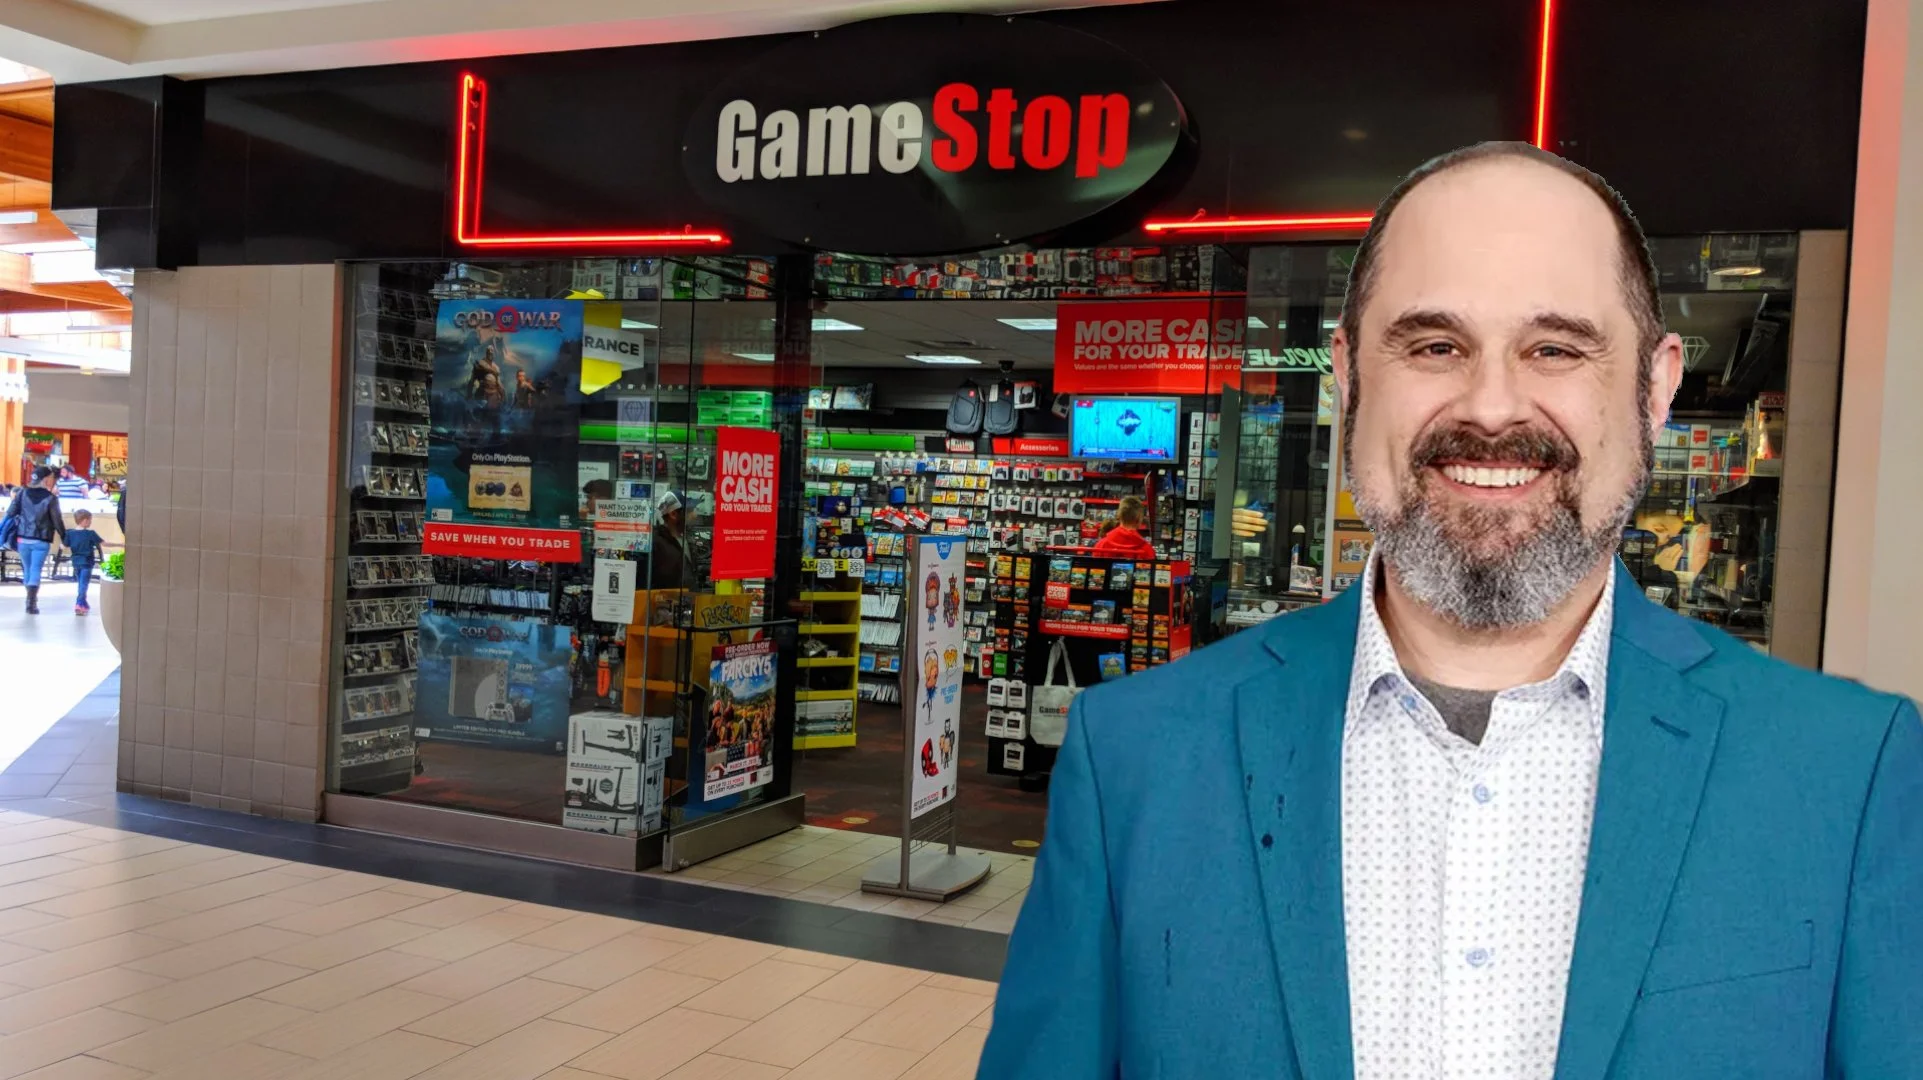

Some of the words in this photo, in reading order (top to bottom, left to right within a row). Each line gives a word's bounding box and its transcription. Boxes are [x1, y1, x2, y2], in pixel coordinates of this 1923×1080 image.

[716, 83, 1129, 183] GameStop
[454, 310, 493, 330] GOD
[501, 313, 513, 324] OF
[518, 311, 563, 331] WAR
[1074, 319, 1163, 344] MORE
[1074, 345, 1111, 360] FOR
[1117, 344, 1170, 360] YOUR
[1138, 362, 1165, 370] whether
[1165, 363, 1179, 372] you
[1179, 362, 1205, 370] choose
[722, 450, 774, 478] MORE
[721, 476, 773, 504] CASH
[720, 503, 733, 512] FOR
[734, 503, 750, 512] YOUR
[750, 504, 773, 513] TRADES
[431, 532, 459, 542] SAVE
[463, 533, 496, 545] WHEN
[501, 536, 525, 547] YOU
[529, 538, 571, 549] TRADE
[725, 643, 755, 654] PRE-ORDER
[756, 640, 770, 649] NOW
